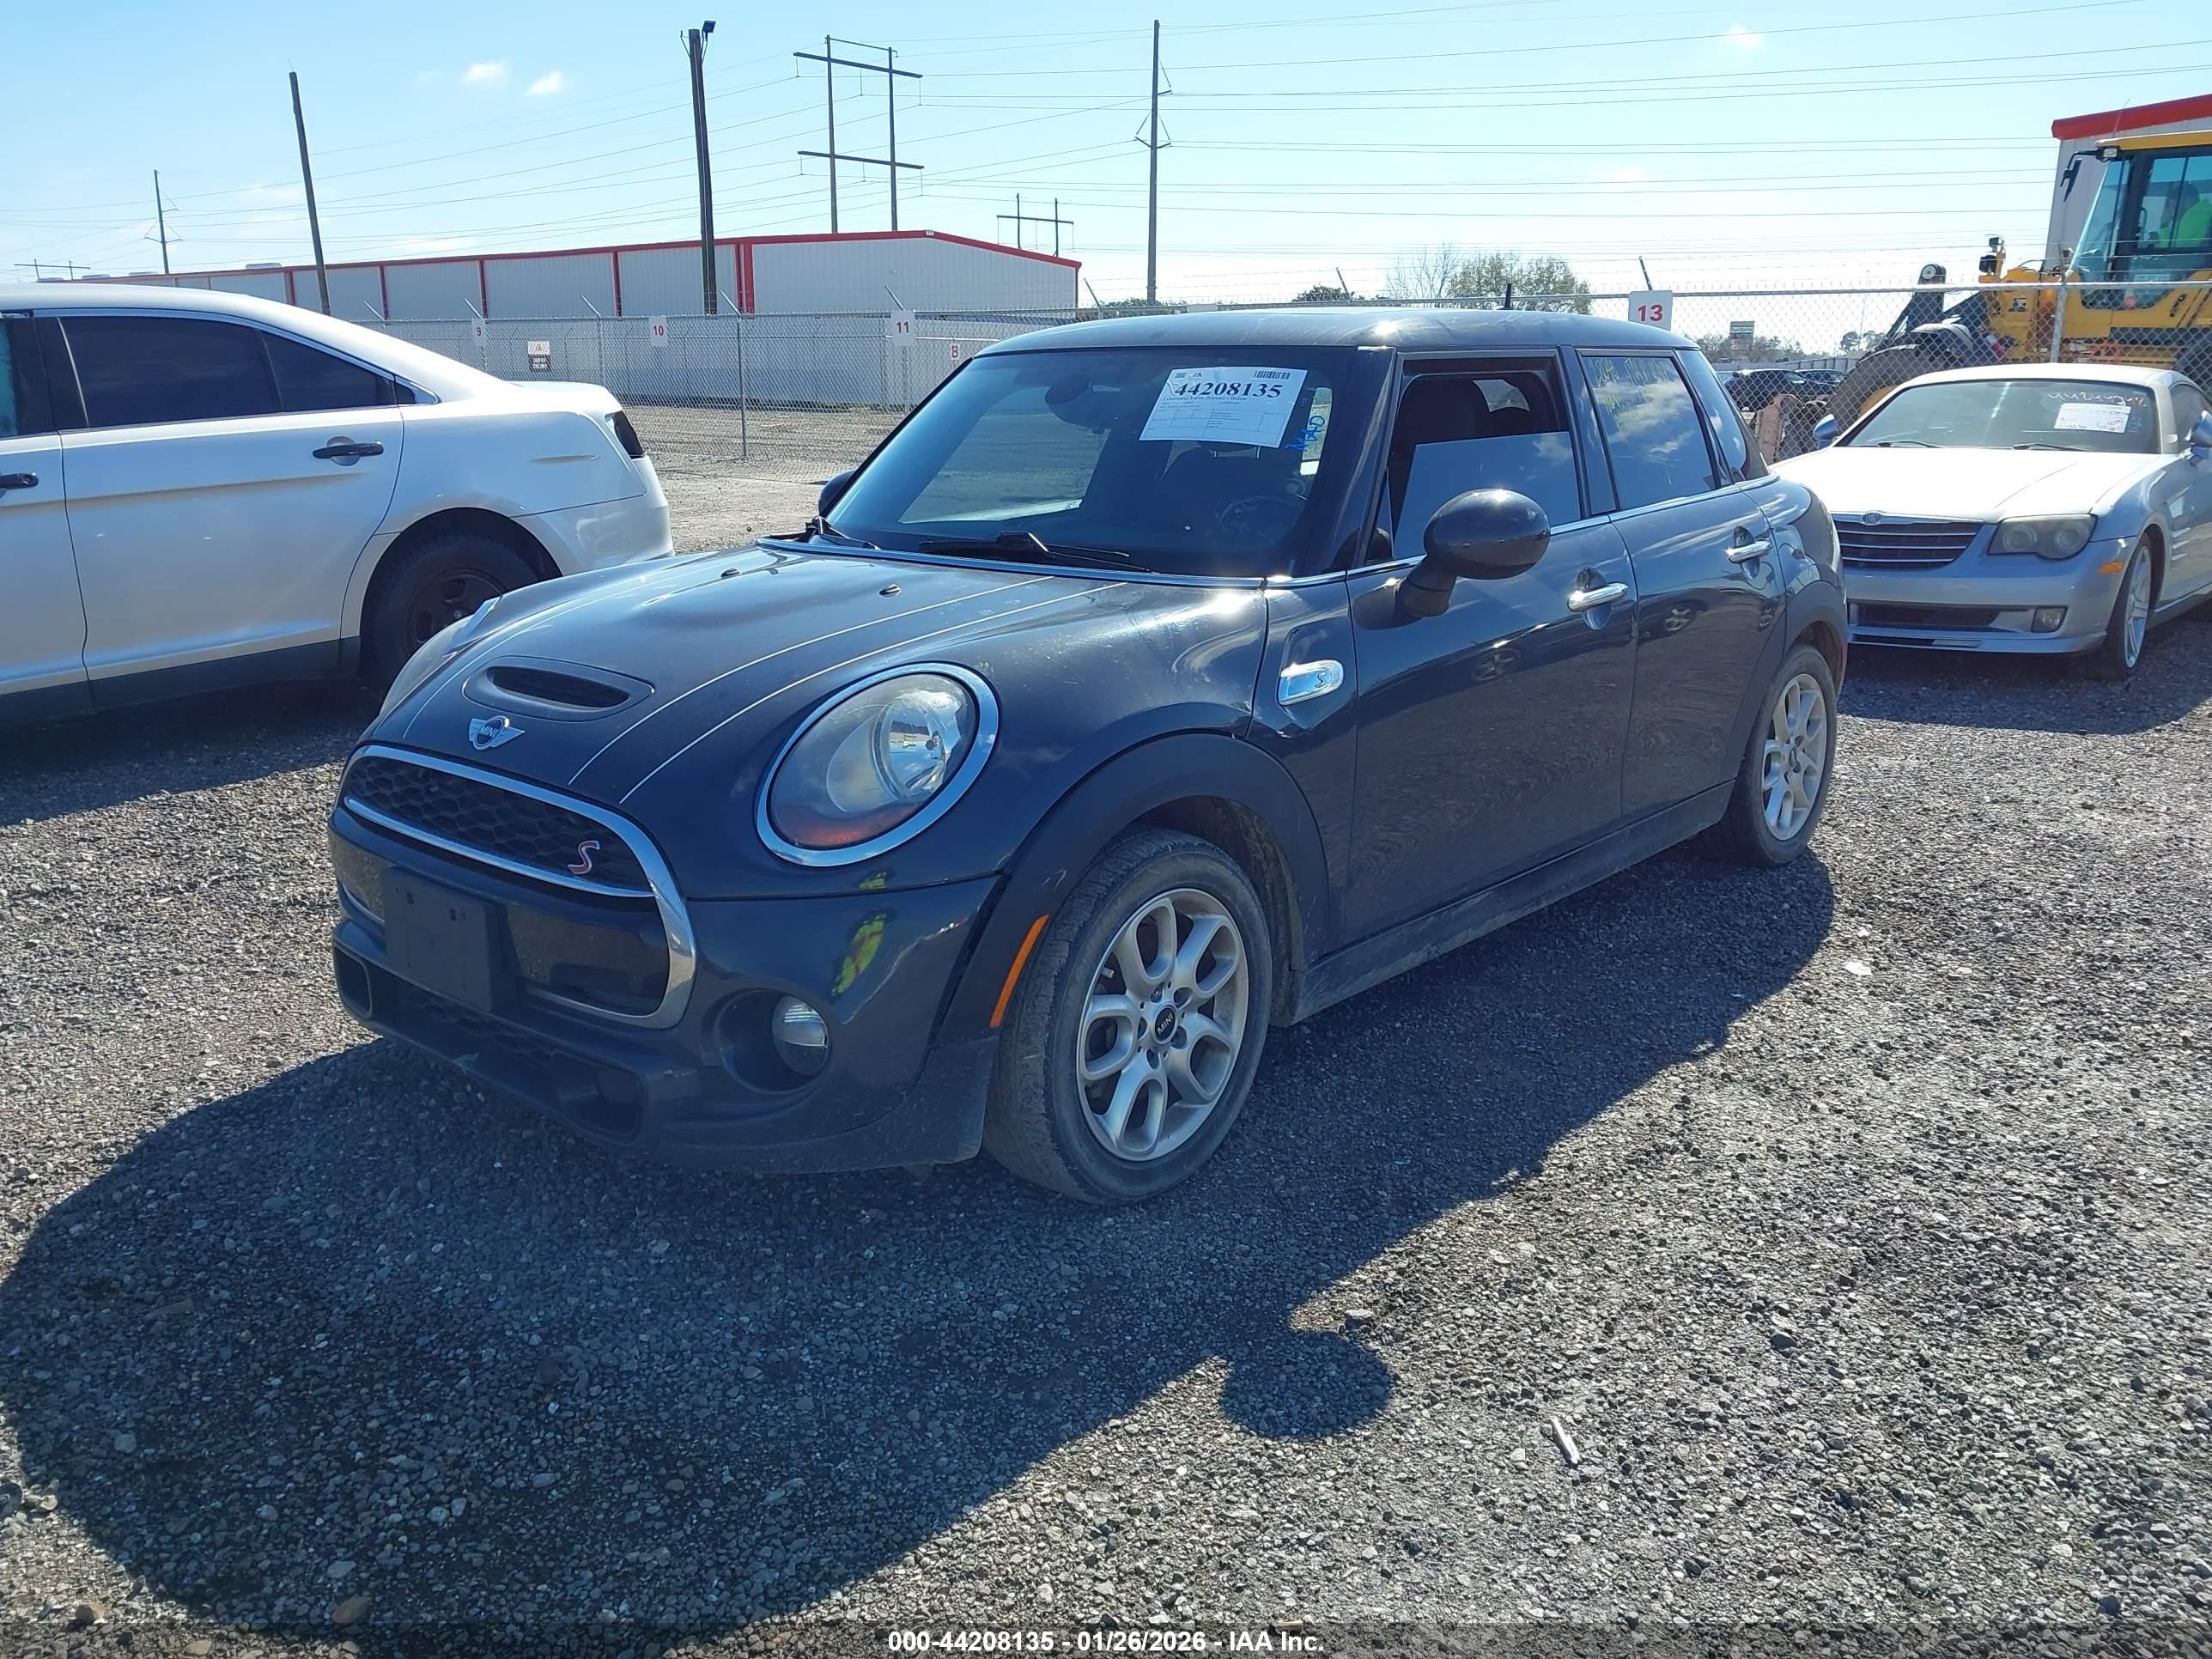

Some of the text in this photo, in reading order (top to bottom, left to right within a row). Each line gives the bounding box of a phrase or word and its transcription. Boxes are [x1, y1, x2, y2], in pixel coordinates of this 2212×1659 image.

[1638, 304, 1663, 322] 13
[476, 326, 482, 337] 9
[653, 325, 665, 337] 10
[896, 320, 909, 334] 11
[951, 345, 959, 358] B
[1174, 381, 1284, 398] 44208135
[1314, 669, 1328, 688] S
[480, 725, 500, 738] MINI
[568, 840, 600, 874] S
[1157, 1012, 1174, 1035] MINI
